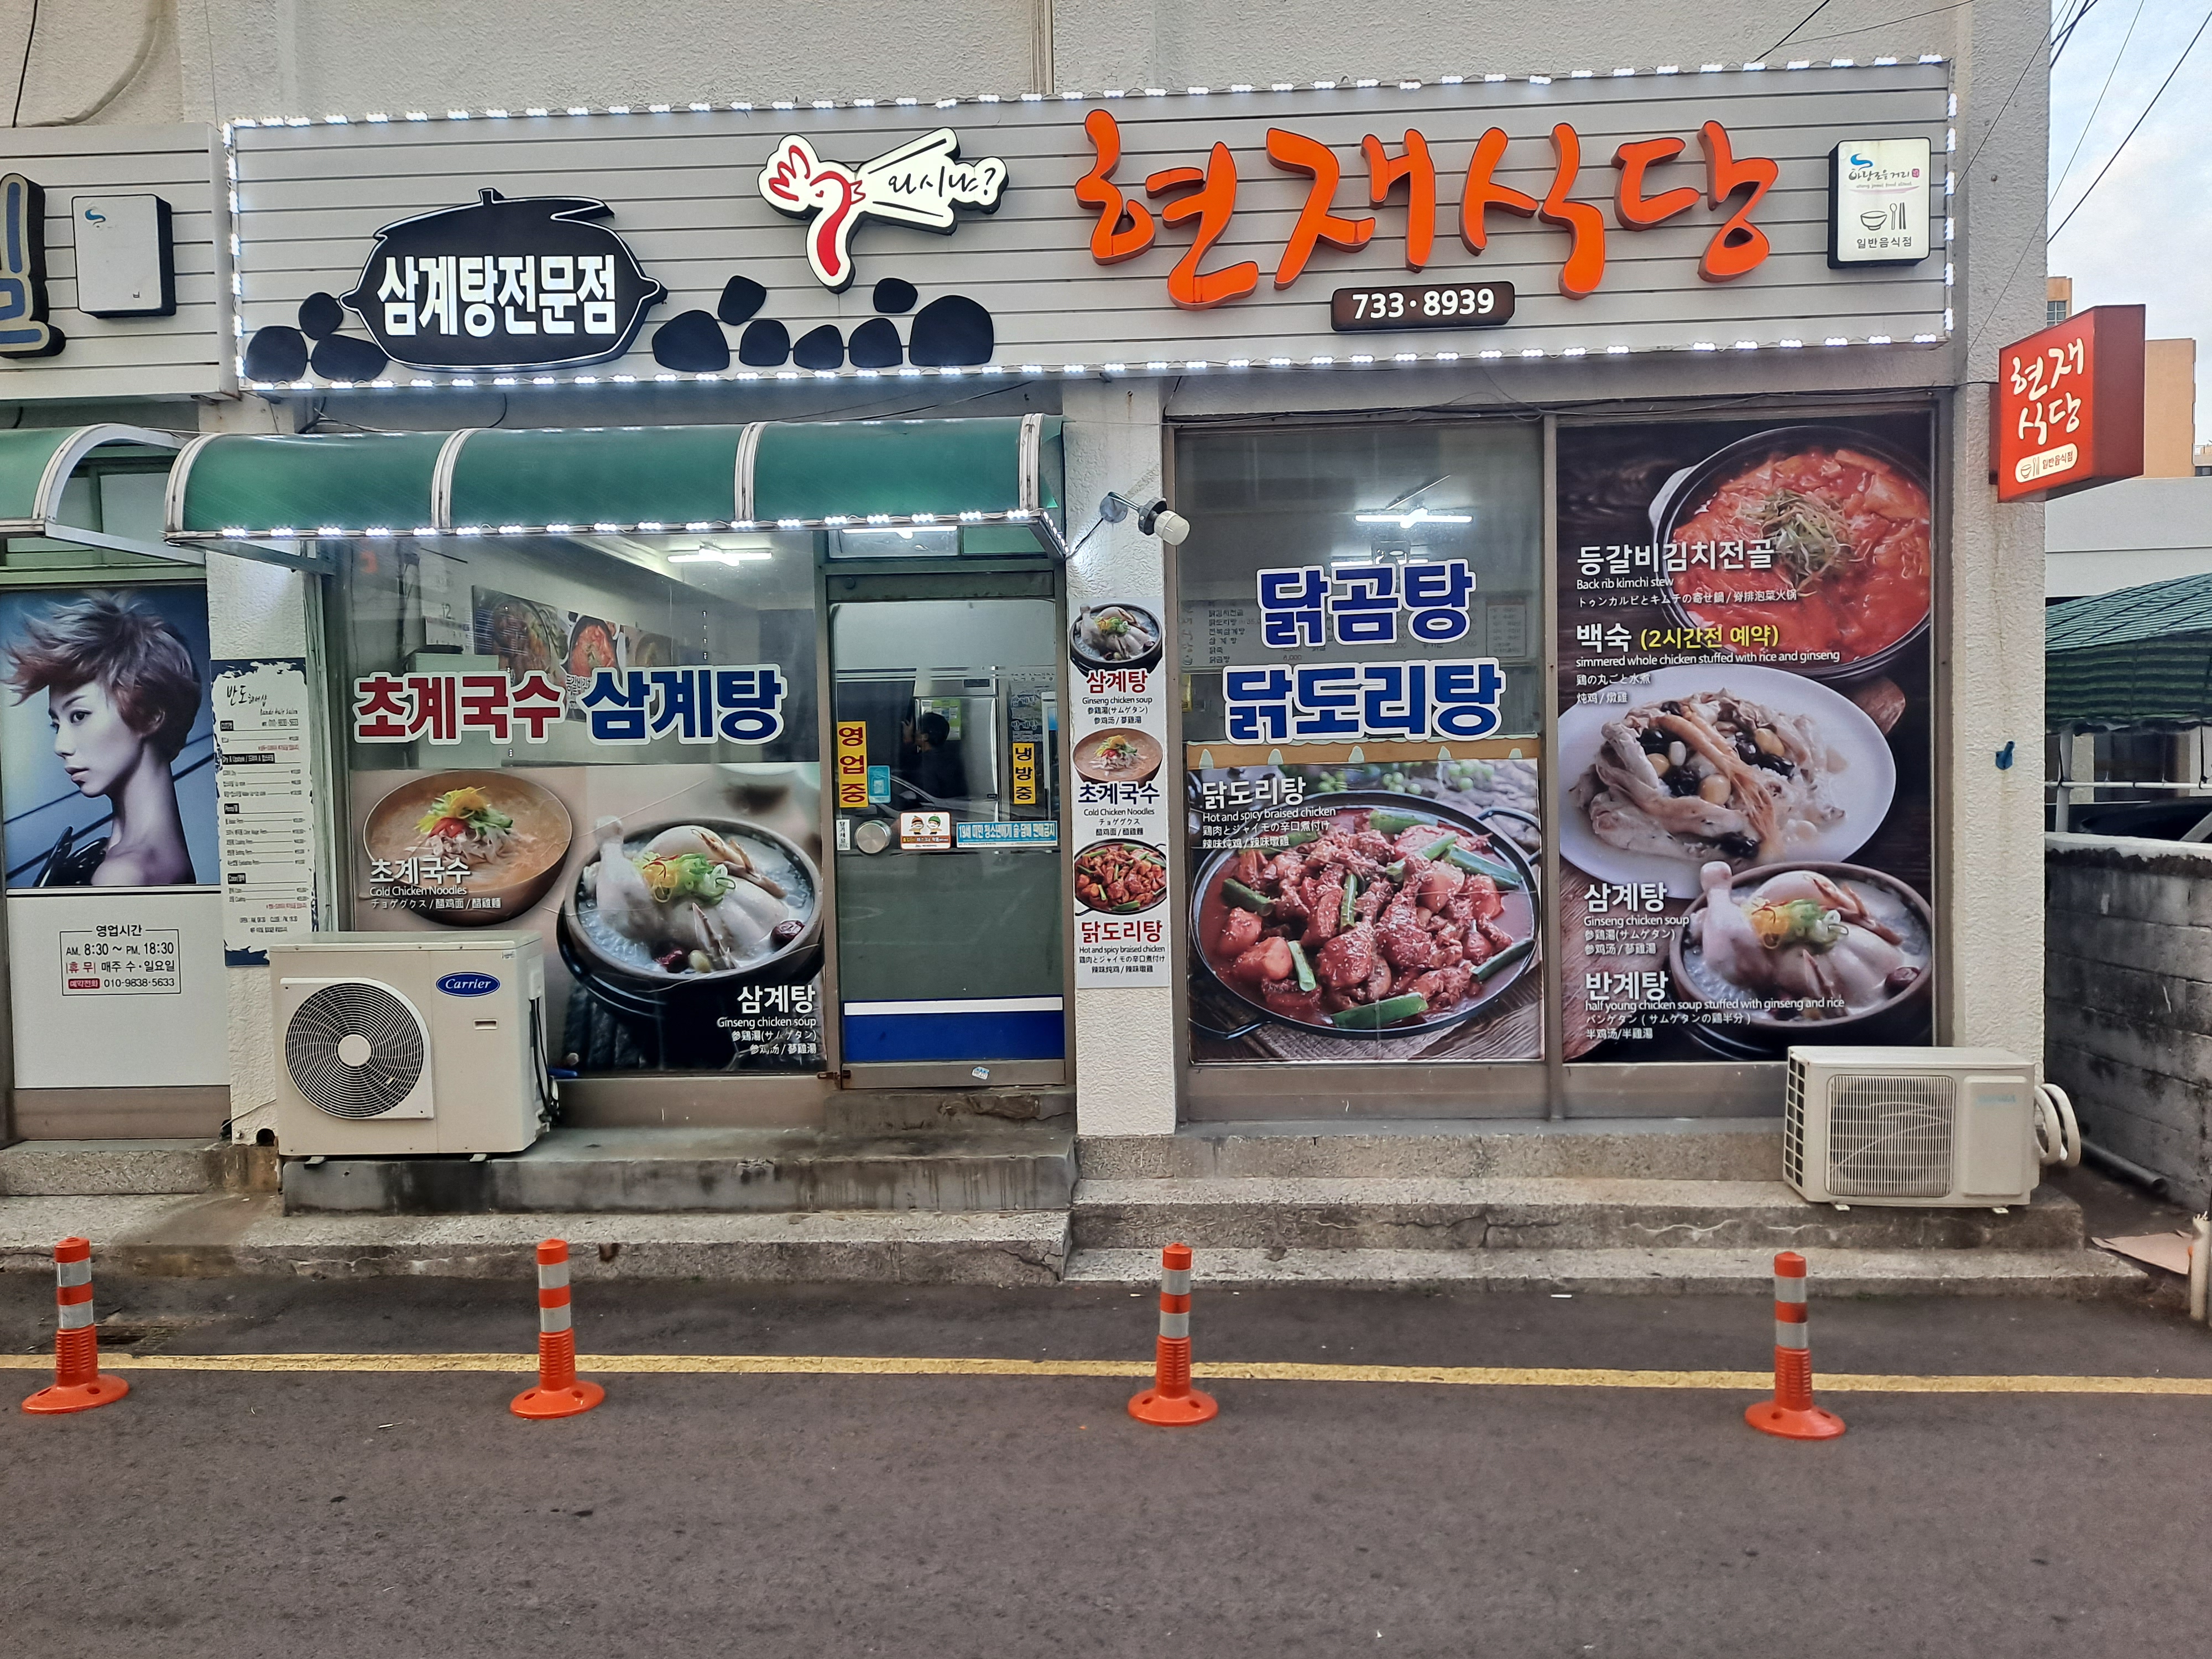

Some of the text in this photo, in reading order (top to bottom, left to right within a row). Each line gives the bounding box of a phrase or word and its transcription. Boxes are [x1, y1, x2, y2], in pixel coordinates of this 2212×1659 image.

[1857, 237, 1912, 248] 일반음식점
[377, 255, 615, 337] 삼계탕전문점
[2011, 338, 2084, 400] 현재
[2018, 392, 2081, 445] 식당
[2043, 451, 2073, 469] 일반음식점
[1577, 539, 1774, 575] 등갈비김치전골
[1577, 577, 1673, 589] Back rib kimchi stew
[1261, 563, 1472, 645] 닭곰탕
[1577, 622, 1778, 653] 백숙 (2시간전 예약)
[1576, 650, 1840, 667] simmered whole chicken stuffed with rice and ginseng
[1087, 671, 1147, 693] 삼계탕
[358, 671, 782, 740] 초계국수 삼계탕
[1227, 665, 1501, 739] 닭도리탕
[1078, 783, 1160, 805] 초계국수
[1203, 776, 1306, 809] 닭도리탕
[1203, 806, 1336, 822] Hot and spicy braised chicken
[369, 857, 470, 885] 초계국수
[370, 885, 467, 896] Cold Chicken Noodles
[1584, 882, 1667, 912] 삼계탕
[96, 925, 142, 937] 영업시간
[1082, 921, 1162, 943] 닭도리탕
[1584, 915, 1689, 928] Ginseng chicken soup
[66, 947, 80, 956] AM.
[84, 943, 108, 956] 8:30
[126, 946, 140, 955] PM.
[144, 942, 174, 954] 18:30
[101, 961, 121, 972] 매주
[446, 979, 491, 989] Carrier
[1585, 970, 1668, 1000] 반계탕
[737, 984, 816, 1014] 삼계탕
[1585, 997, 1844, 1013] half young chicken soup stuffed with ginseng and rice
[717, 1016, 816, 1029] Ginseng chicken soup
